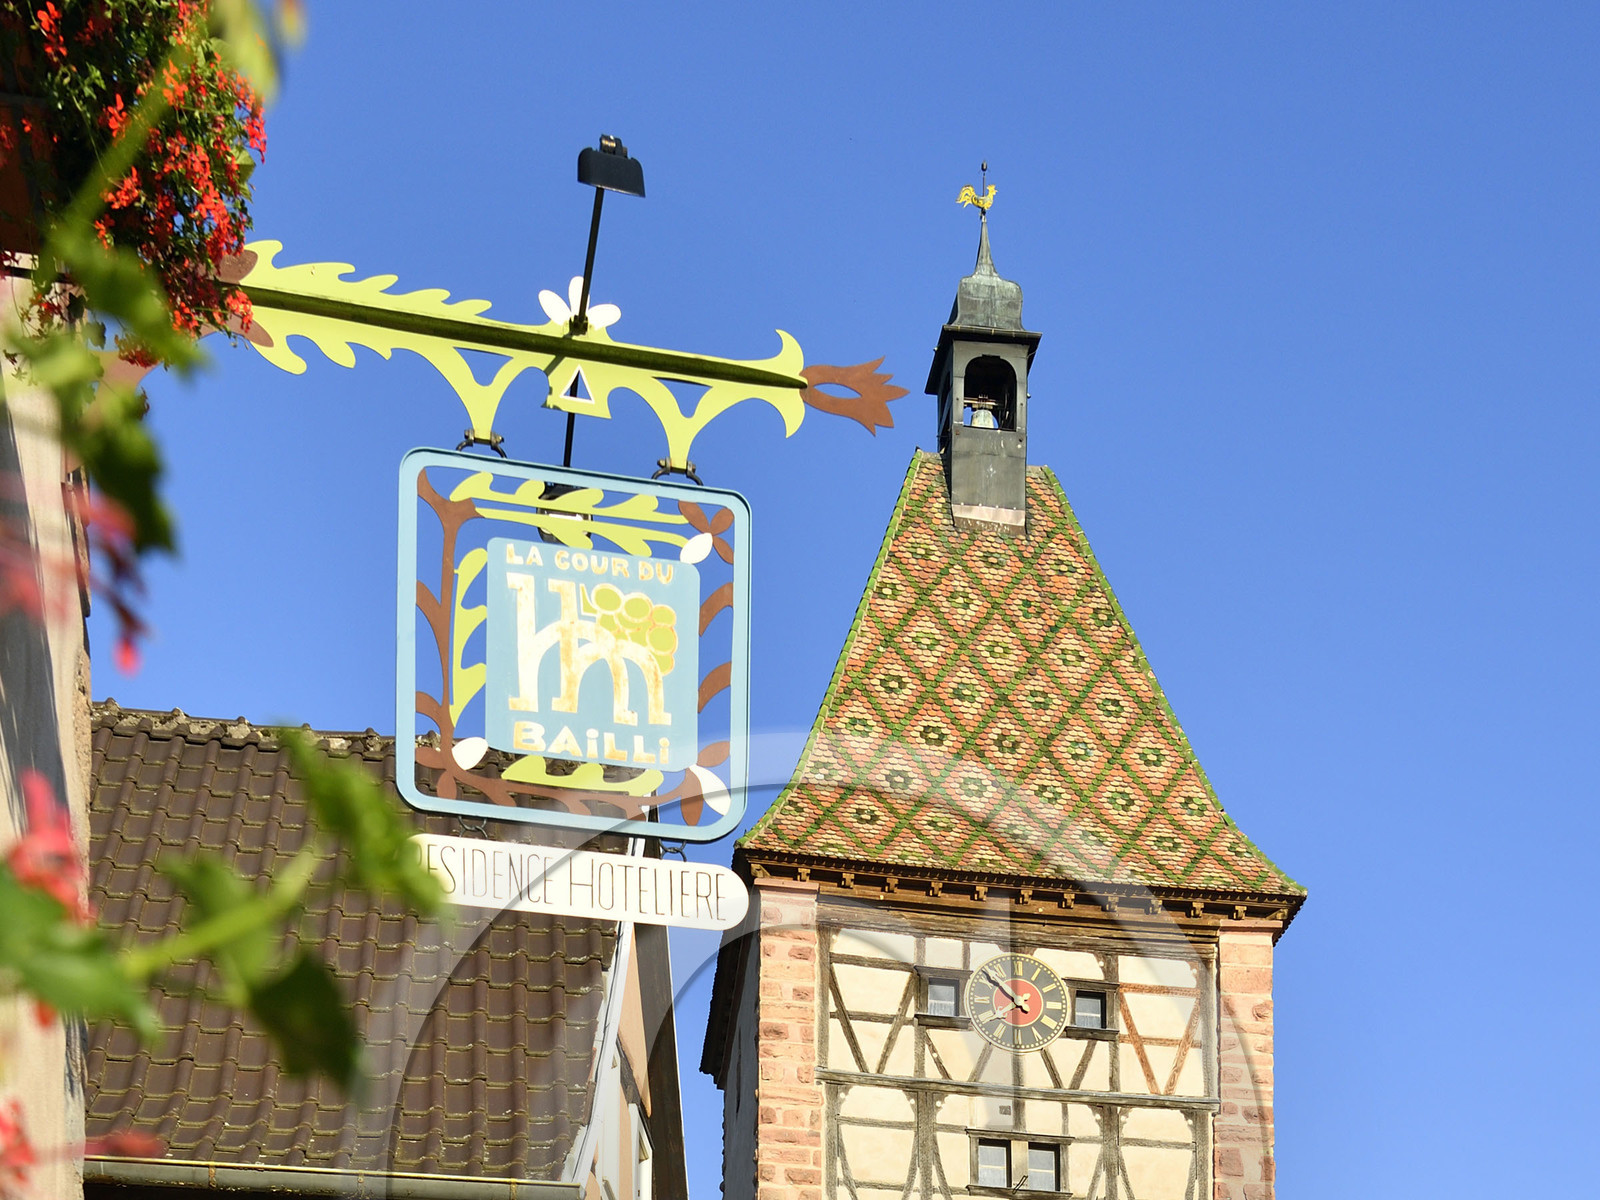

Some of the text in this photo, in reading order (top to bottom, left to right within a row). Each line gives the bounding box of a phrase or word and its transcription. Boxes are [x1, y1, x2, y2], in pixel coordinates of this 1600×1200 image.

[506, 543, 674, 585] LA COUR DU
[569, 856, 727, 921] HOTELIERE
